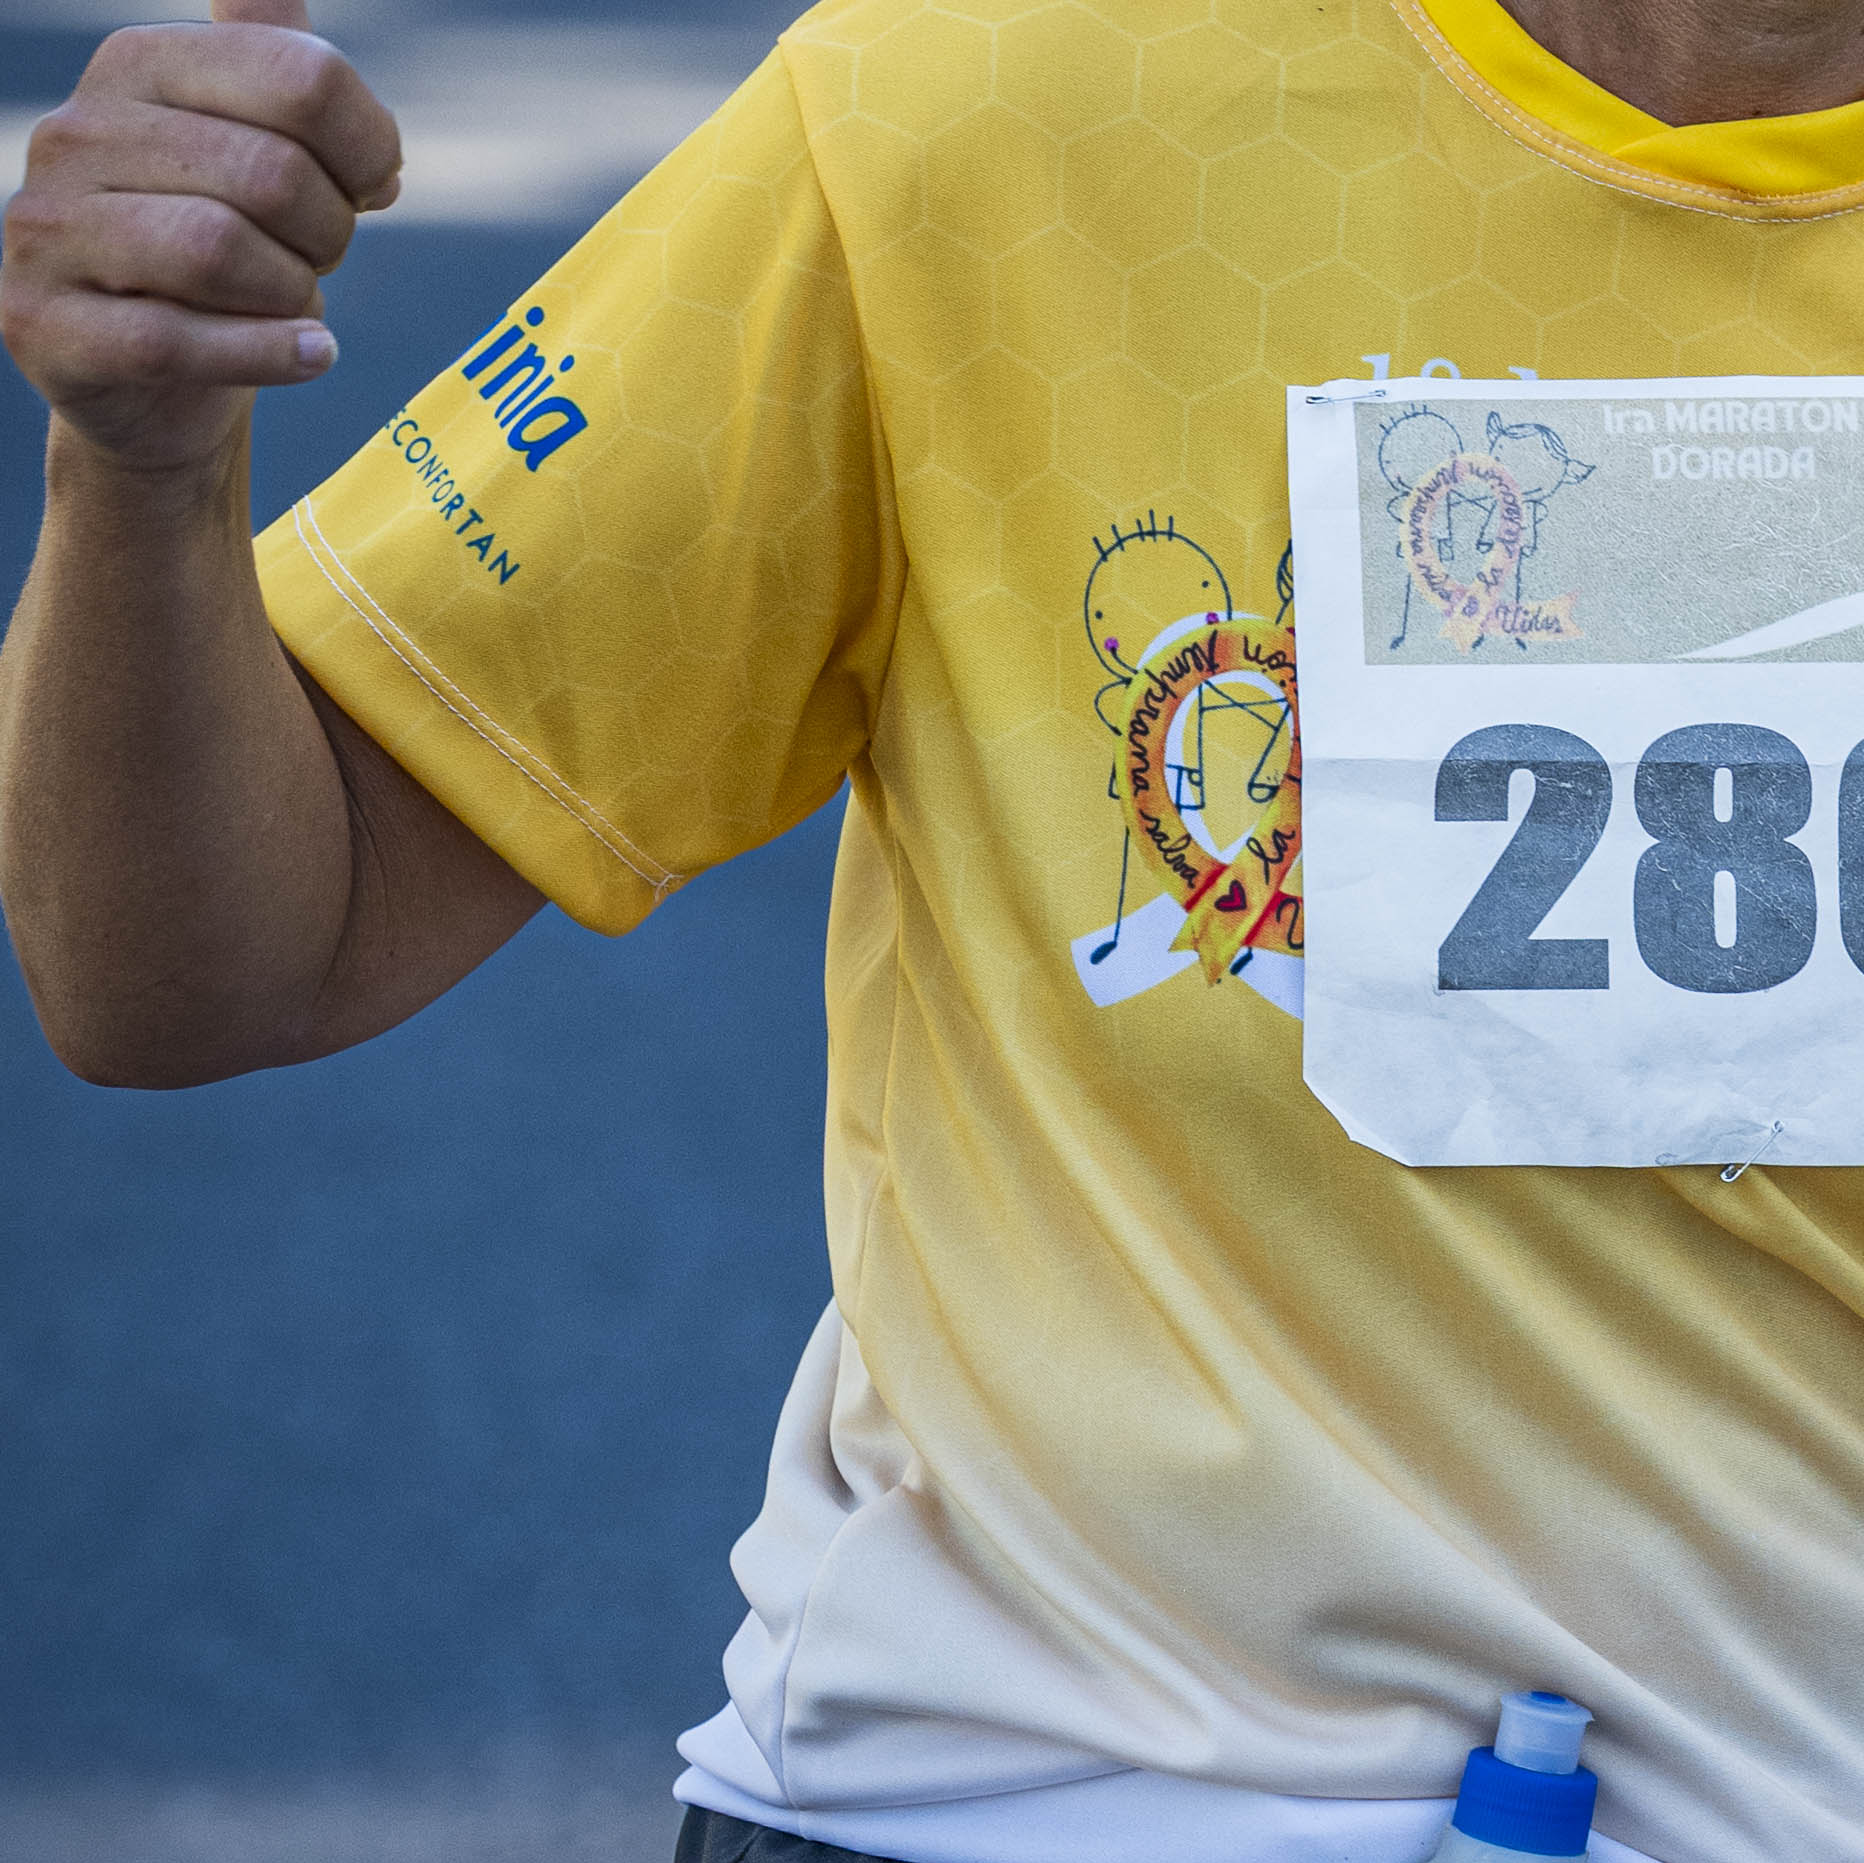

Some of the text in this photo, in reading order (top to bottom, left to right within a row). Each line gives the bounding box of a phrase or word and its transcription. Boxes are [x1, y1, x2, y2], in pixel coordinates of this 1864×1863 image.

[450, 306, 588, 472] inia
[384, 408, 520, 585] CONFORTAN
[1652, 445, 1816, 480] DORADA
[1139, 809, 1200, 889] salva
